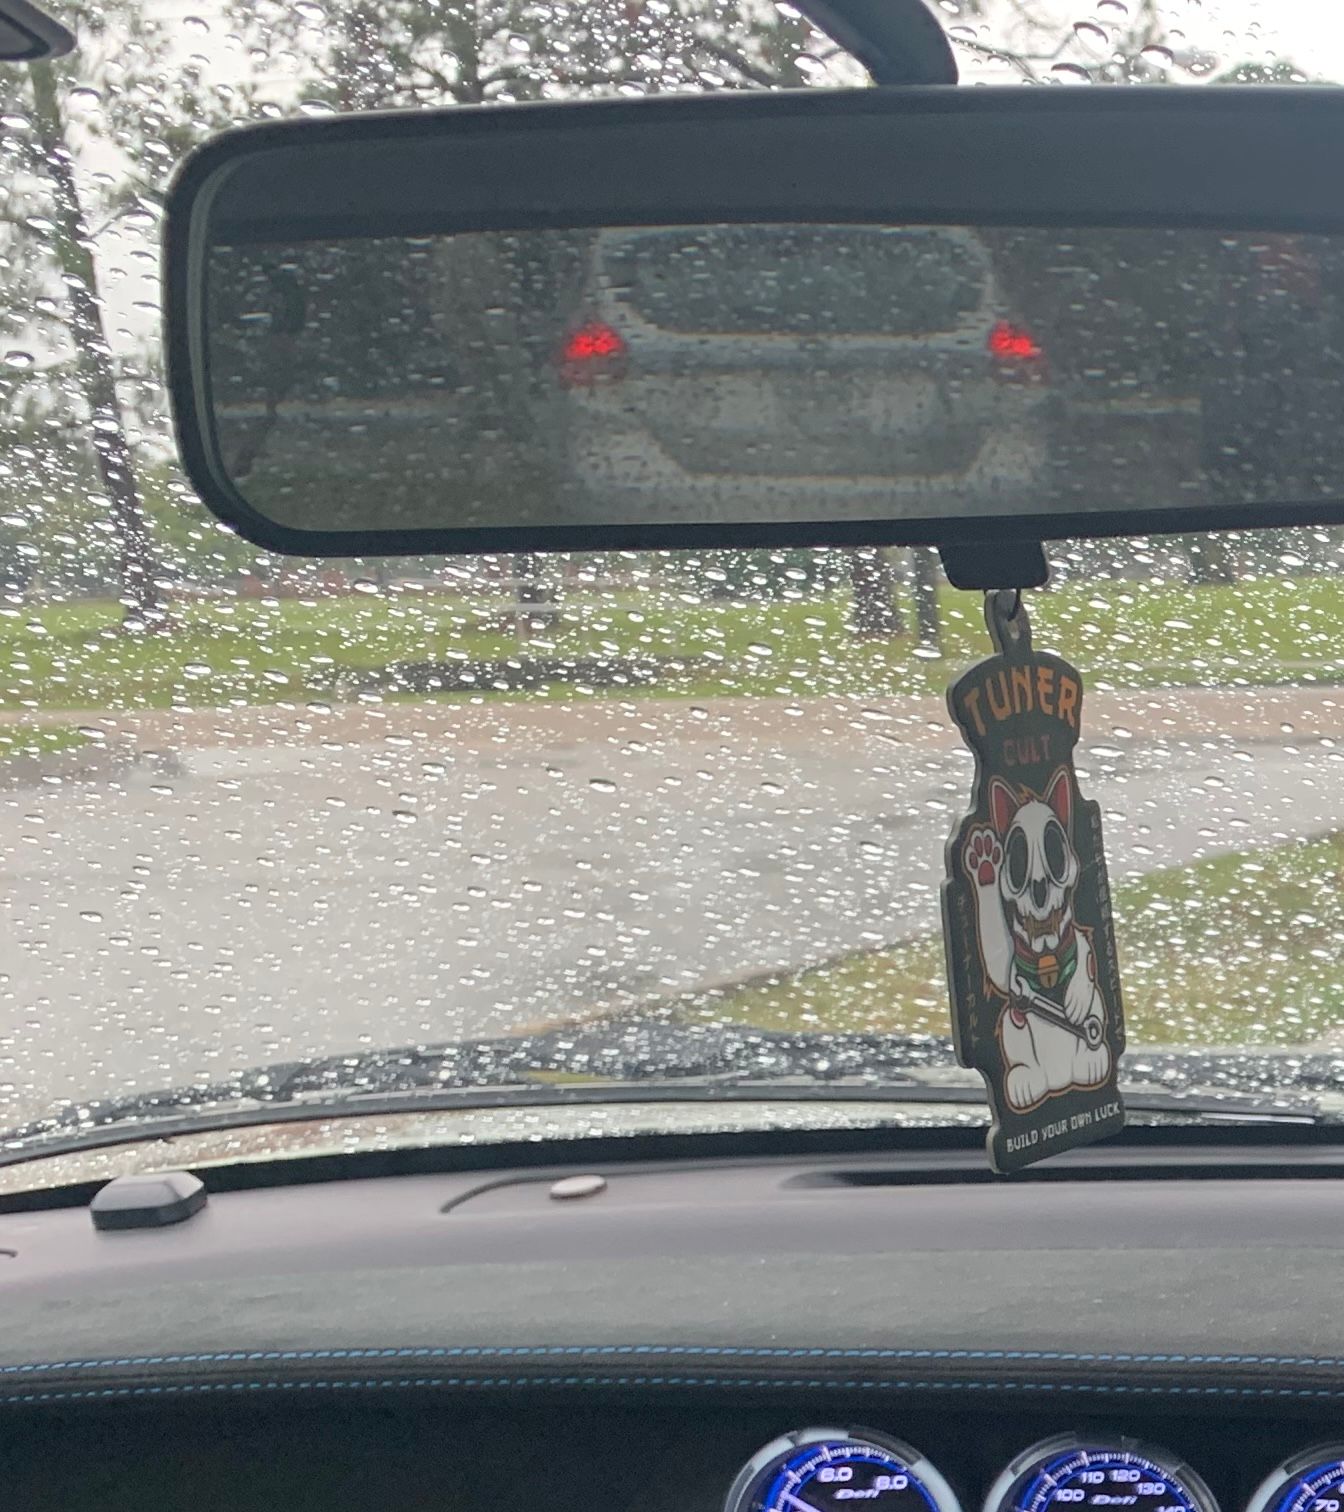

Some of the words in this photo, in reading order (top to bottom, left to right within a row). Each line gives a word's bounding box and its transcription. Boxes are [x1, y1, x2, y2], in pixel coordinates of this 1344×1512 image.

[963, 663, 1081, 737] TUNER
[1003, 733, 1052, 767] CULT
[1005, 1128, 1040, 1153] BUILD
[1041, 1121, 1069, 1146] YOUR
[1069, 1111, 1093, 1136] OWN
[1093, 1101, 1121, 1127] LUCK
[1081, 1471, 1104, 1484] 110
[1111, 1470, 1140, 1482] 120
[1056, 1489, 1085, 1501] 100
[1136, 1483, 1166, 1495] 130
[1314, 1499, 1339, 1512] 70
